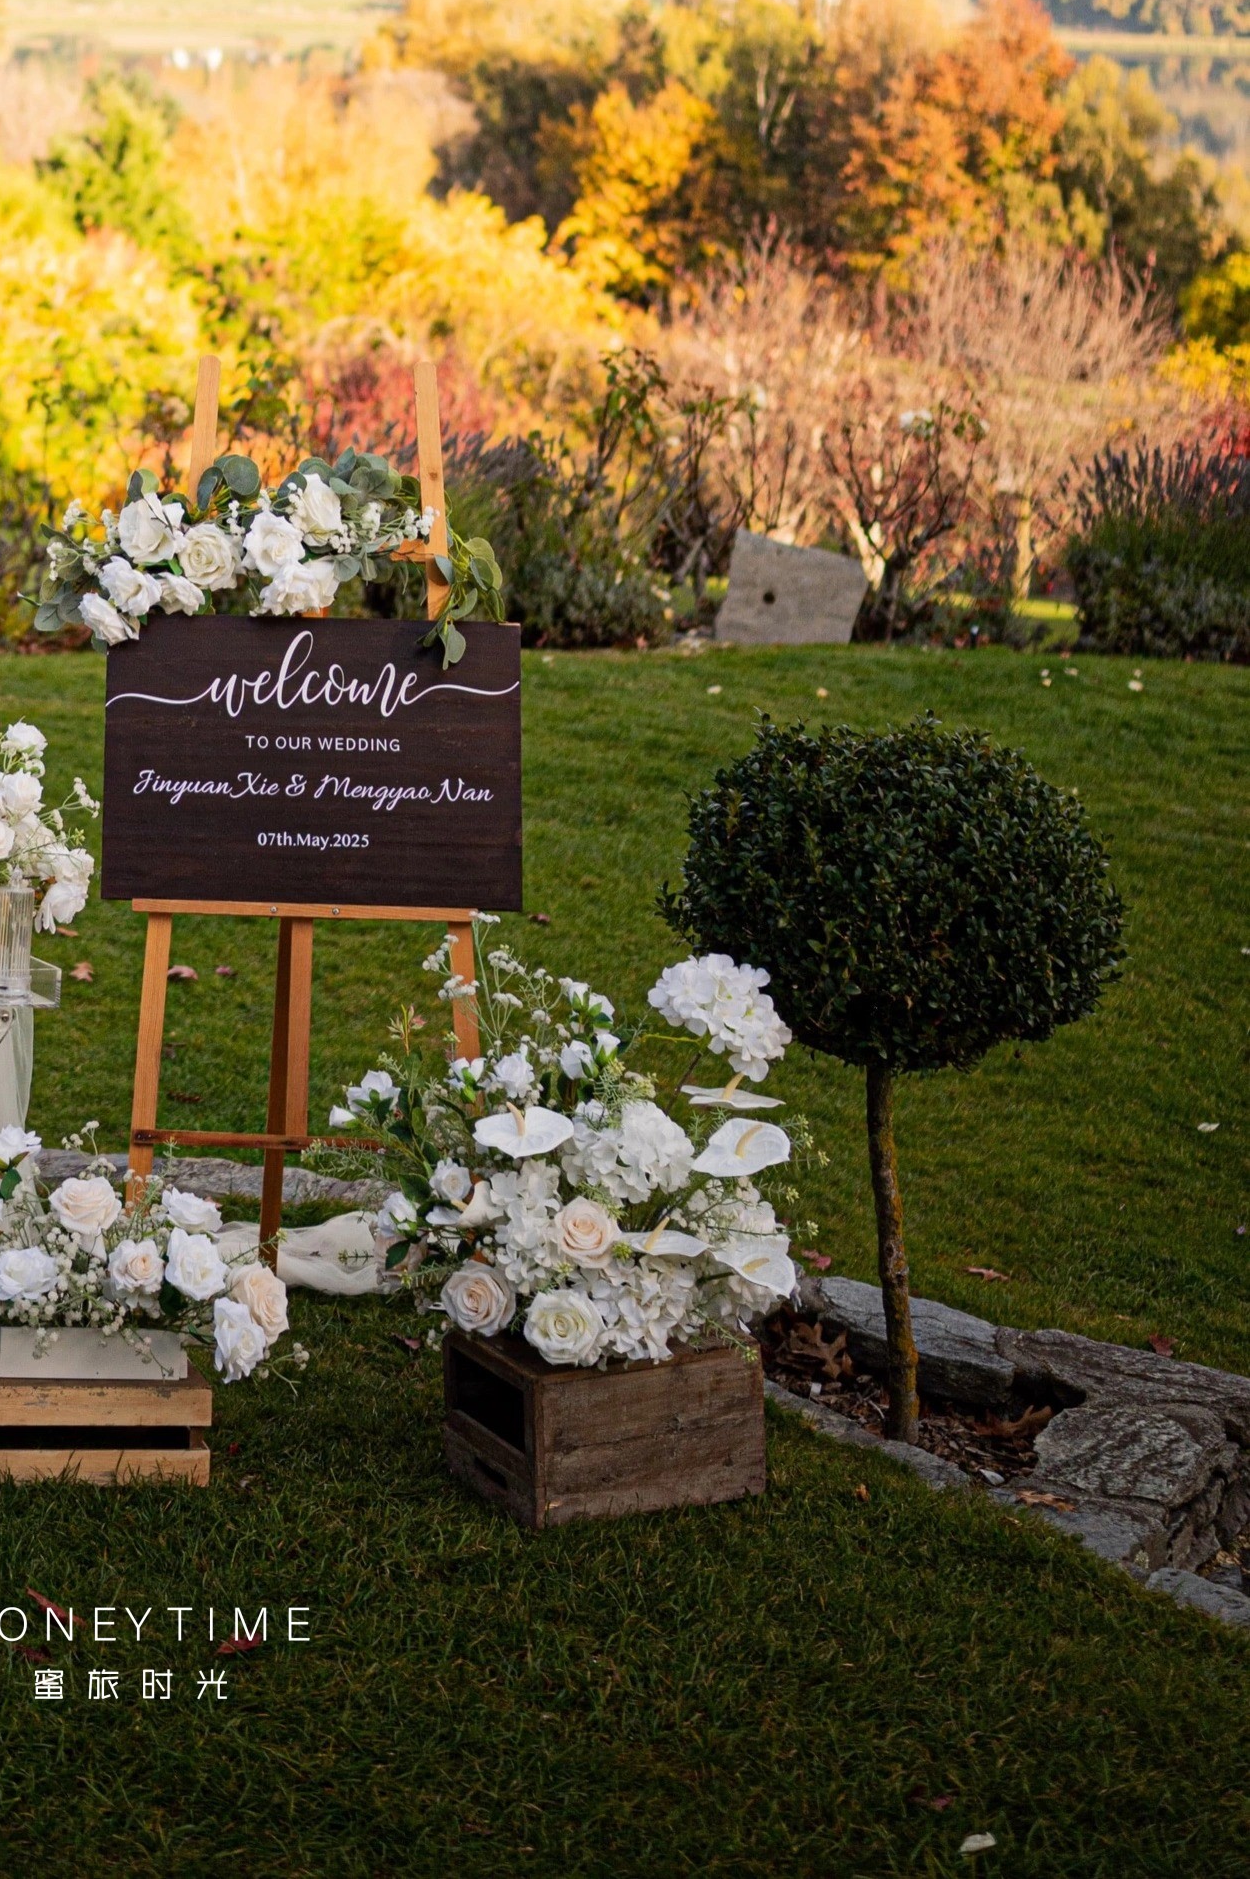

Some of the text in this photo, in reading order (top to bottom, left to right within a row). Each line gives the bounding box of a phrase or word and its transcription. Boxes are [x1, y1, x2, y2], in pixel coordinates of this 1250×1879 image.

[105, 630, 520, 718] welcome
[245, 734, 401, 753] TO OUR WEDDING
[132, 768, 495, 812] Jinyuan Xie & Mengyao Nan
[256, 831, 370, 851] 07th.May.2025
